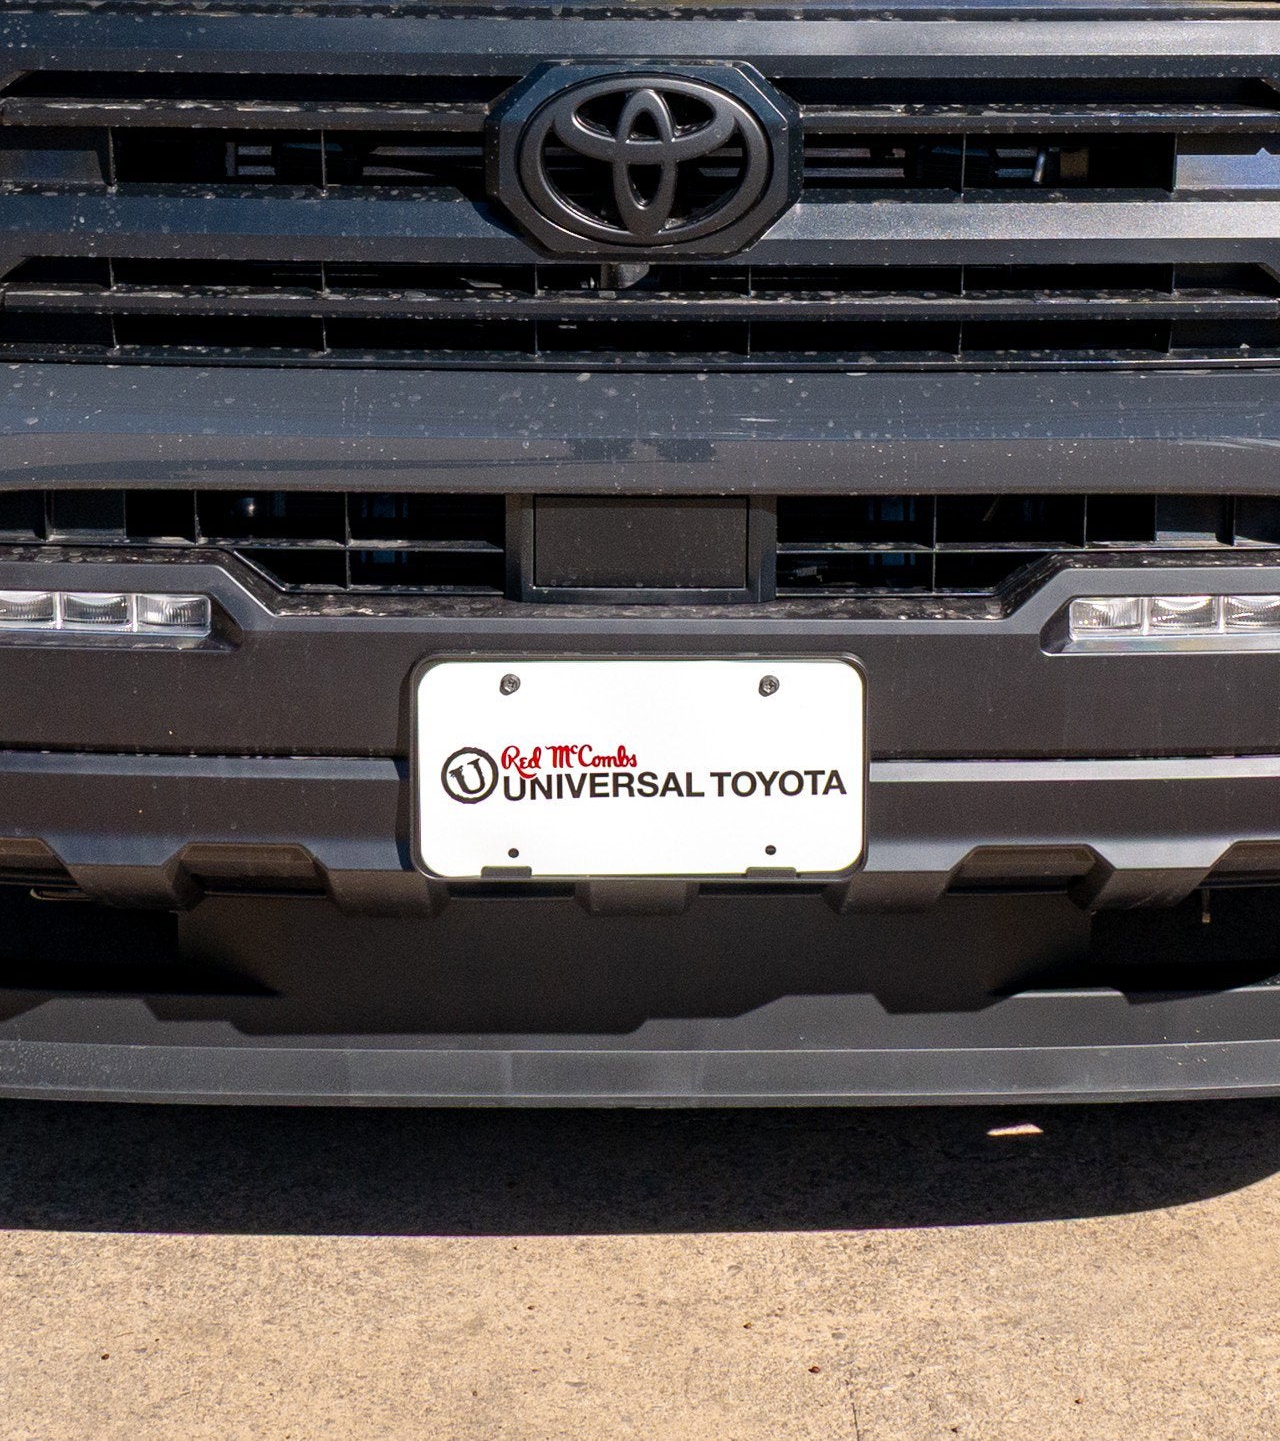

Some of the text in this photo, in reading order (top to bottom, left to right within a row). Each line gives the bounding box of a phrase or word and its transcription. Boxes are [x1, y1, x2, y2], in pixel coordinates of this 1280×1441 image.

[501, 744, 637, 779] Red McCombs
[503, 769, 848, 801] UNIVERSAL TOYOTA
